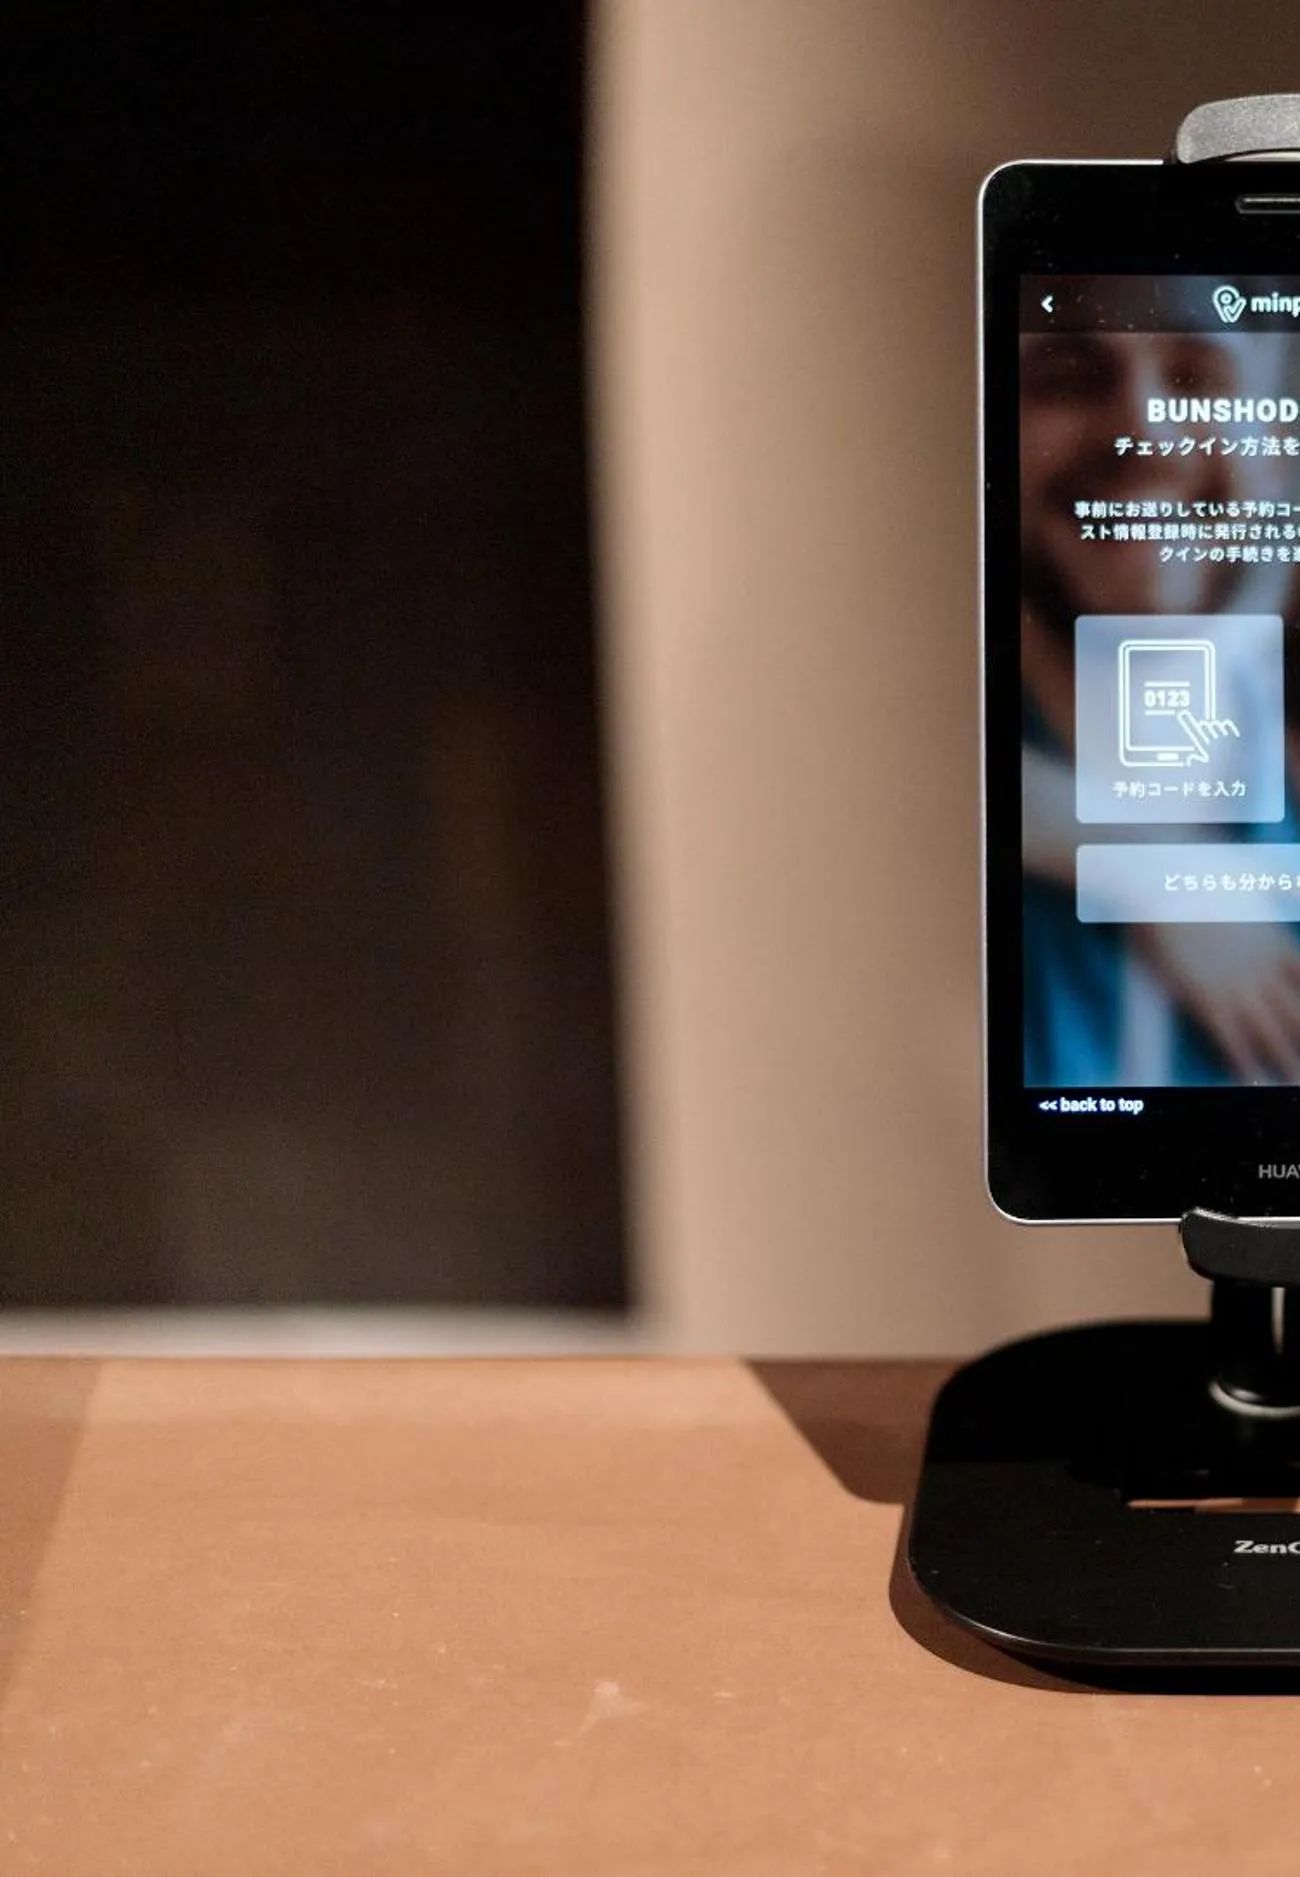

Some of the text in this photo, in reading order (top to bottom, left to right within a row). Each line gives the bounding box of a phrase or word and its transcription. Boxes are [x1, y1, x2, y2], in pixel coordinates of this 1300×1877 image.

[1144, 689, 1190, 708] 0123
[1112, 780, 1248, 798] 予約コードを入力
[1060, 1096, 1098, 1113] back
[1099, 1098, 1116, 1113] to
[1119, 1098, 1144, 1115] top
